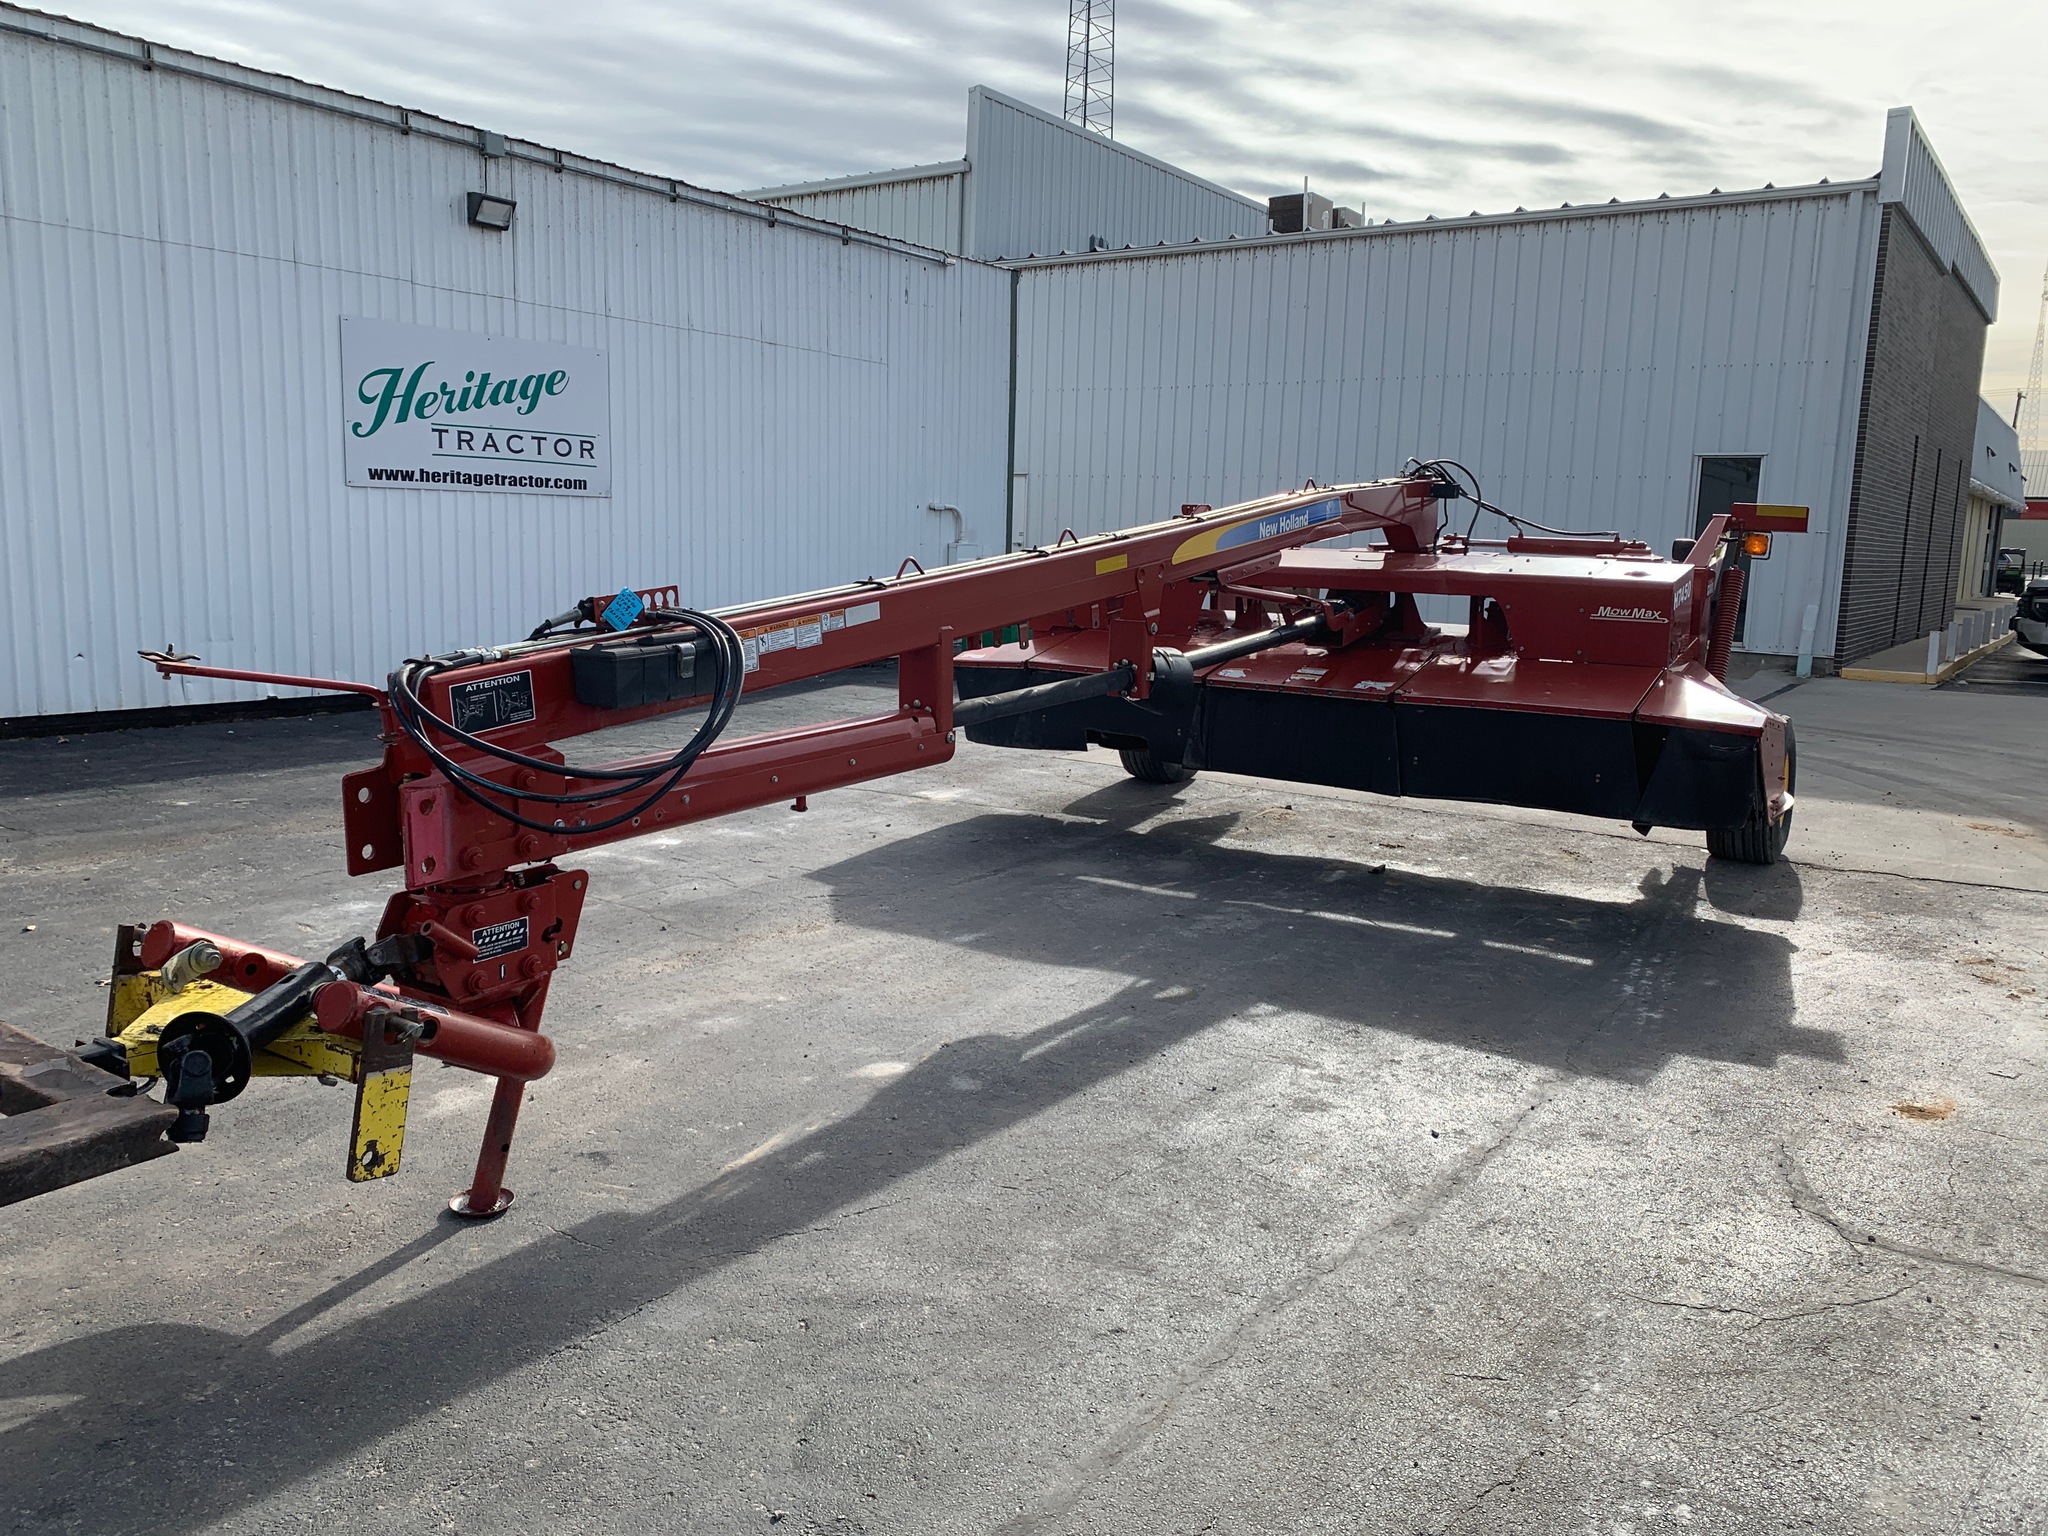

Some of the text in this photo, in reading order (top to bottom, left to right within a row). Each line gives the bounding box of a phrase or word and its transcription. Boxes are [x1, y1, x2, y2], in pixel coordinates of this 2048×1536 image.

[352, 361, 570, 438] Heritage
[431, 428, 596, 460] TRACTOR
[367, 467, 588, 490] www.heritagetractor.com
[1259, 510, 1309, 539] New Holland
[465, 675, 520, 693] ATTENTION
[482, 921, 520, 937] ATTENTION
